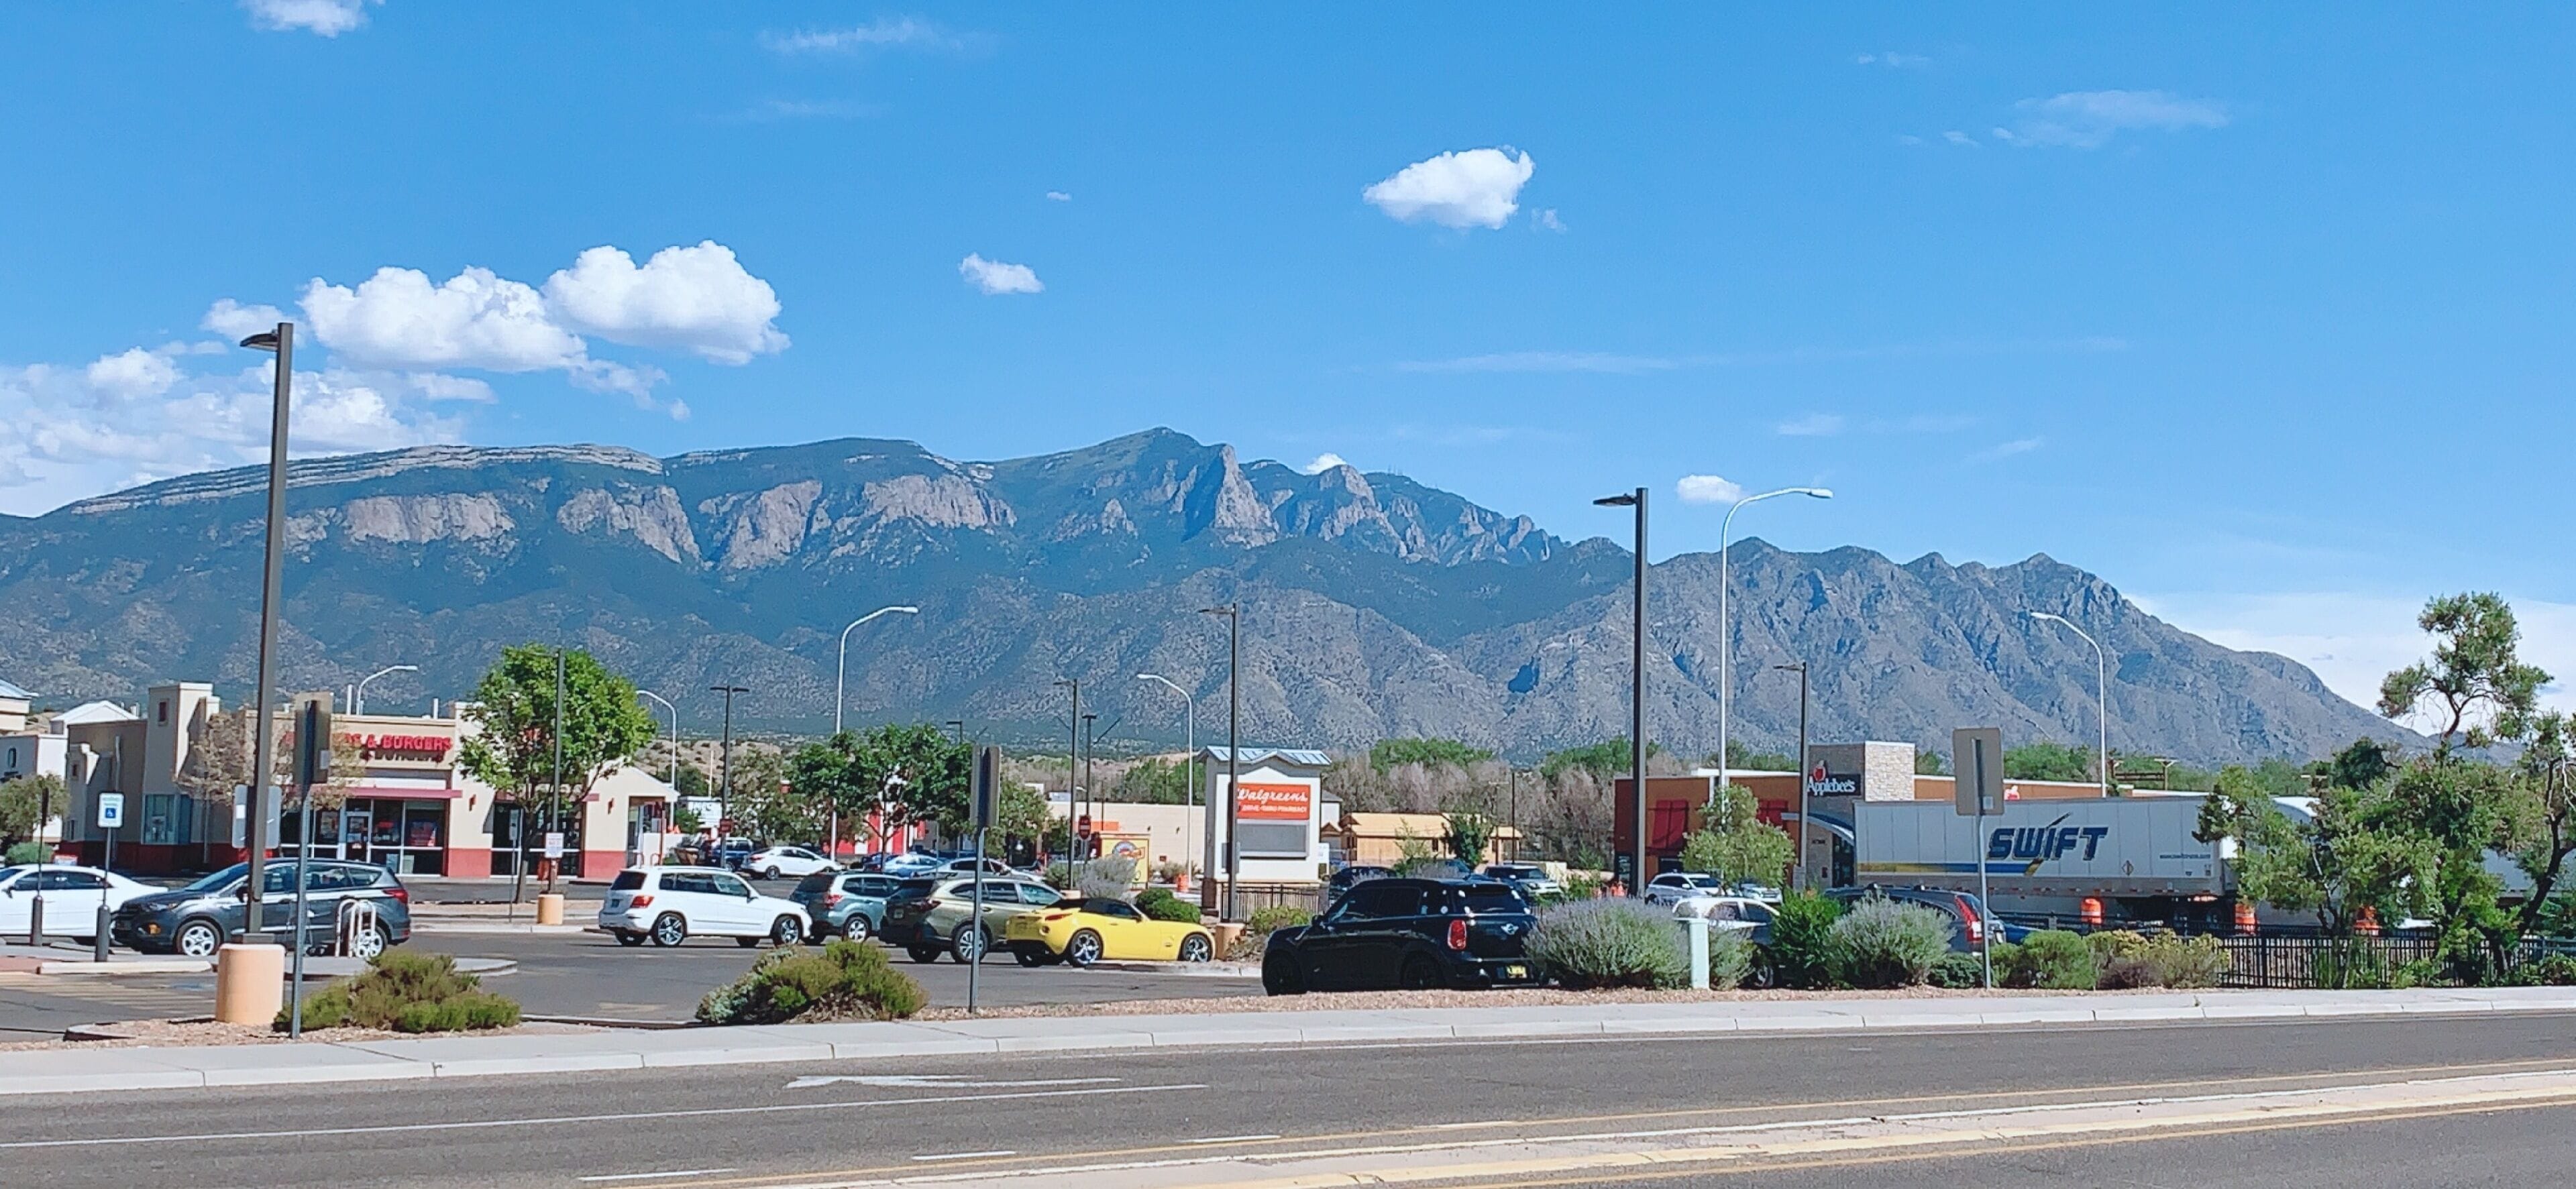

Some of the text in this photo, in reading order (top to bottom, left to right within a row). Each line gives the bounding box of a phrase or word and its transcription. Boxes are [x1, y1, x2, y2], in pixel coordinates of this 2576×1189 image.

[366, 734, 377, 748] &
[382, 734, 452, 751] BURGERS
[1807, 775, 1856, 796] Applebee's
[1237, 788, 1308, 805] Walgreens
[1986, 827, 2108, 860] SWIFT
